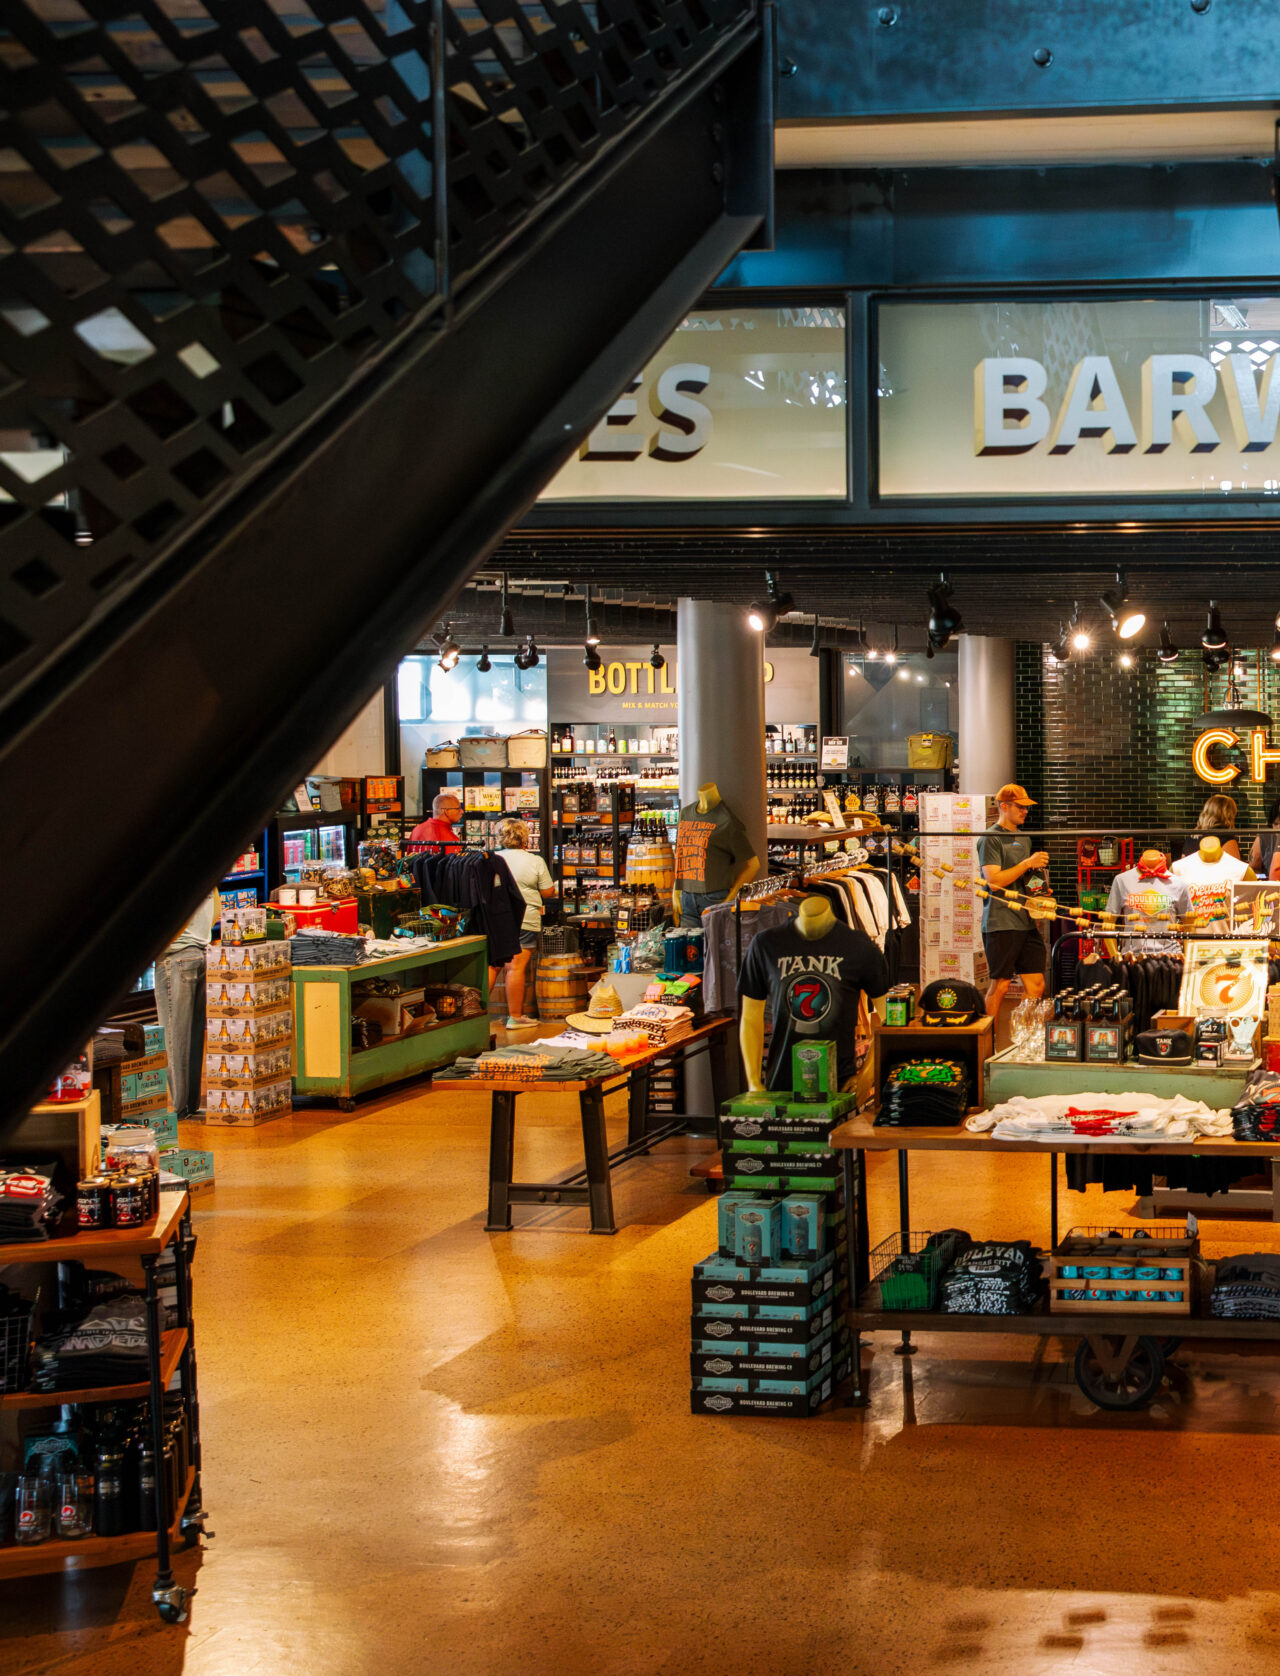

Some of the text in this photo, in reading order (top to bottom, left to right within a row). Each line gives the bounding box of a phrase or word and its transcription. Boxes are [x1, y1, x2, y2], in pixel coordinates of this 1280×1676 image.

[588, 661, 678, 694] BOTTL
[777, 956, 844, 980] TANK
[794, 983, 820, 1017] 7
[1216, 974, 1240, 1004] 7
[1160, 1044, 1168, 1052] 7
